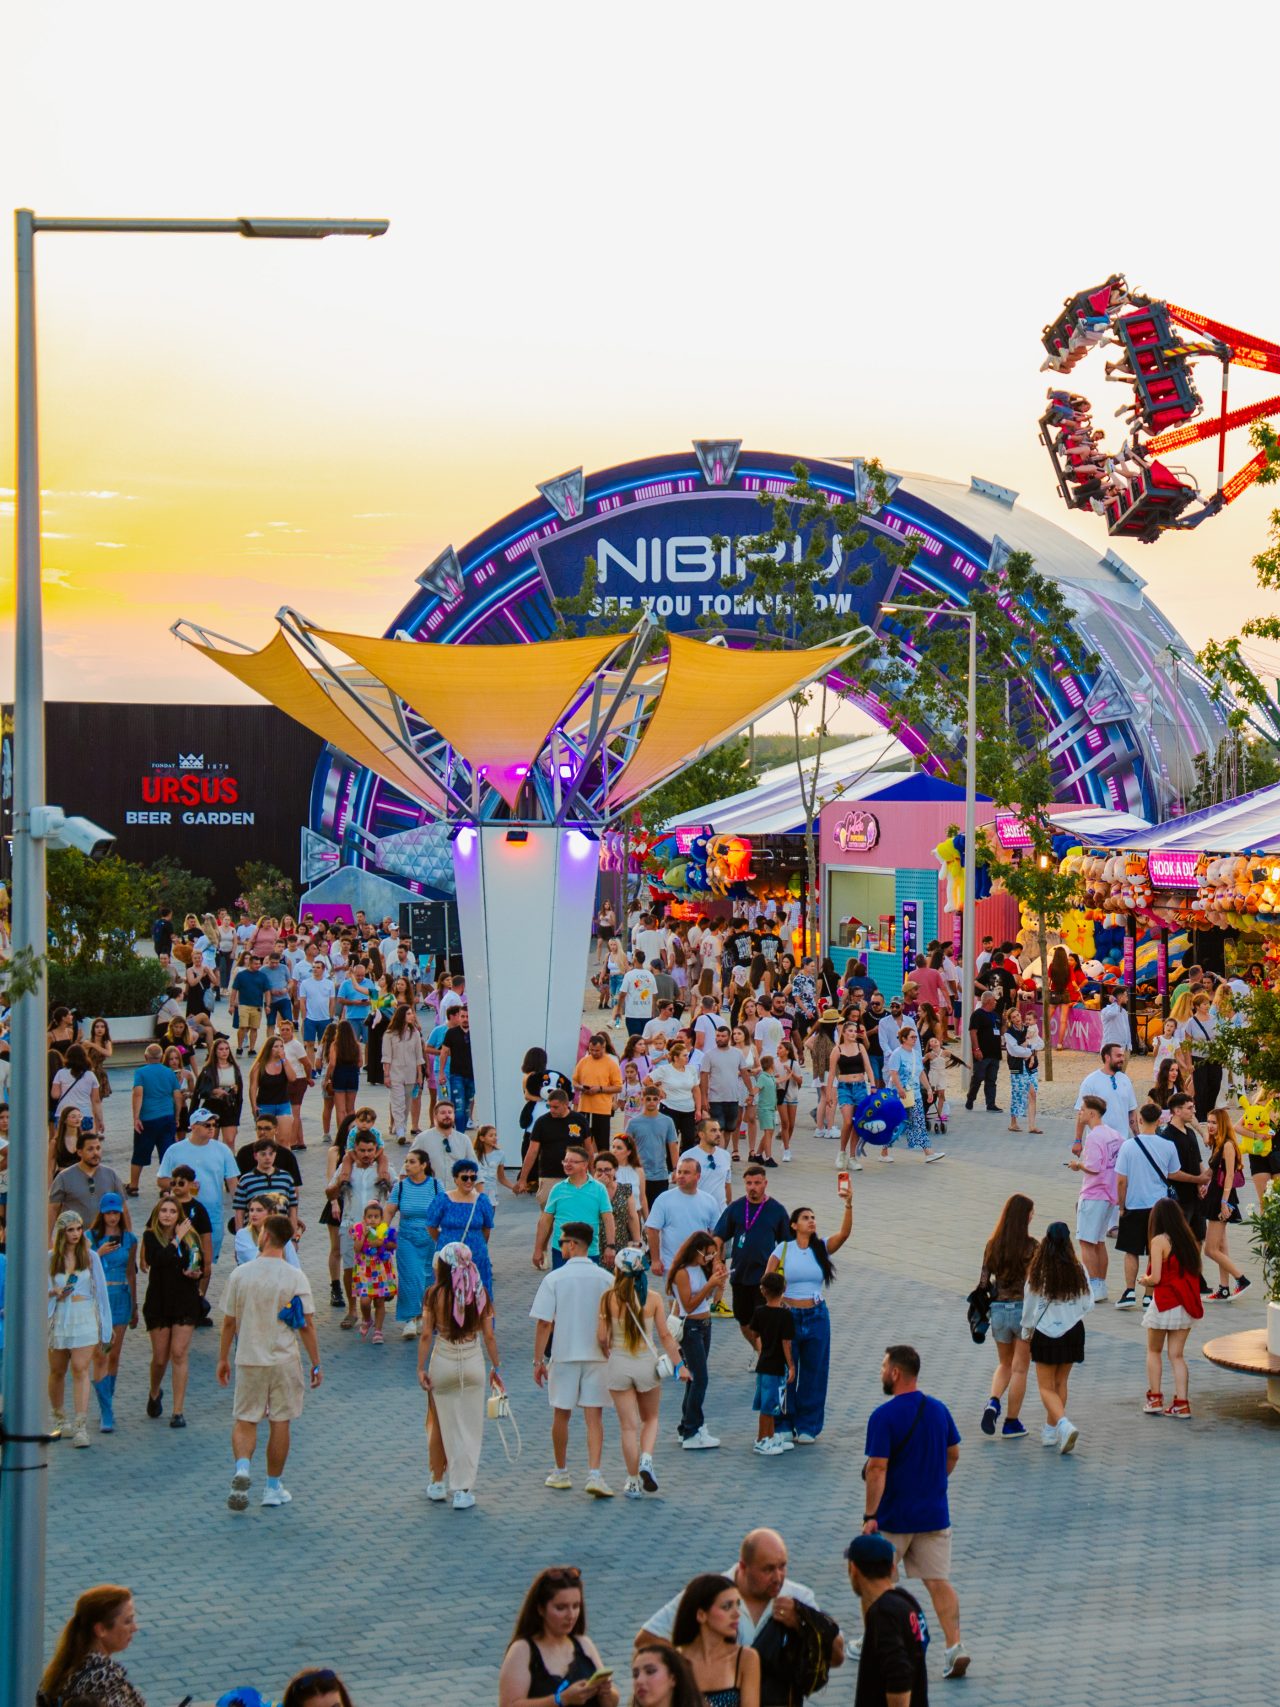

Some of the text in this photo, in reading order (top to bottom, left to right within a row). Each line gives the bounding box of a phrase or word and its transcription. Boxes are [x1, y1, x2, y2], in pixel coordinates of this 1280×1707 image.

[597, 534, 843, 583] NIBIRU
[698, 593, 853, 616] TOMOROW
[142, 774, 239, 807] URSUS
[126, 811, 255, 825] BEER GARDEN
[1152, 860, 1175, 876] HOOK
[1176, 861, 1183, 876] A
